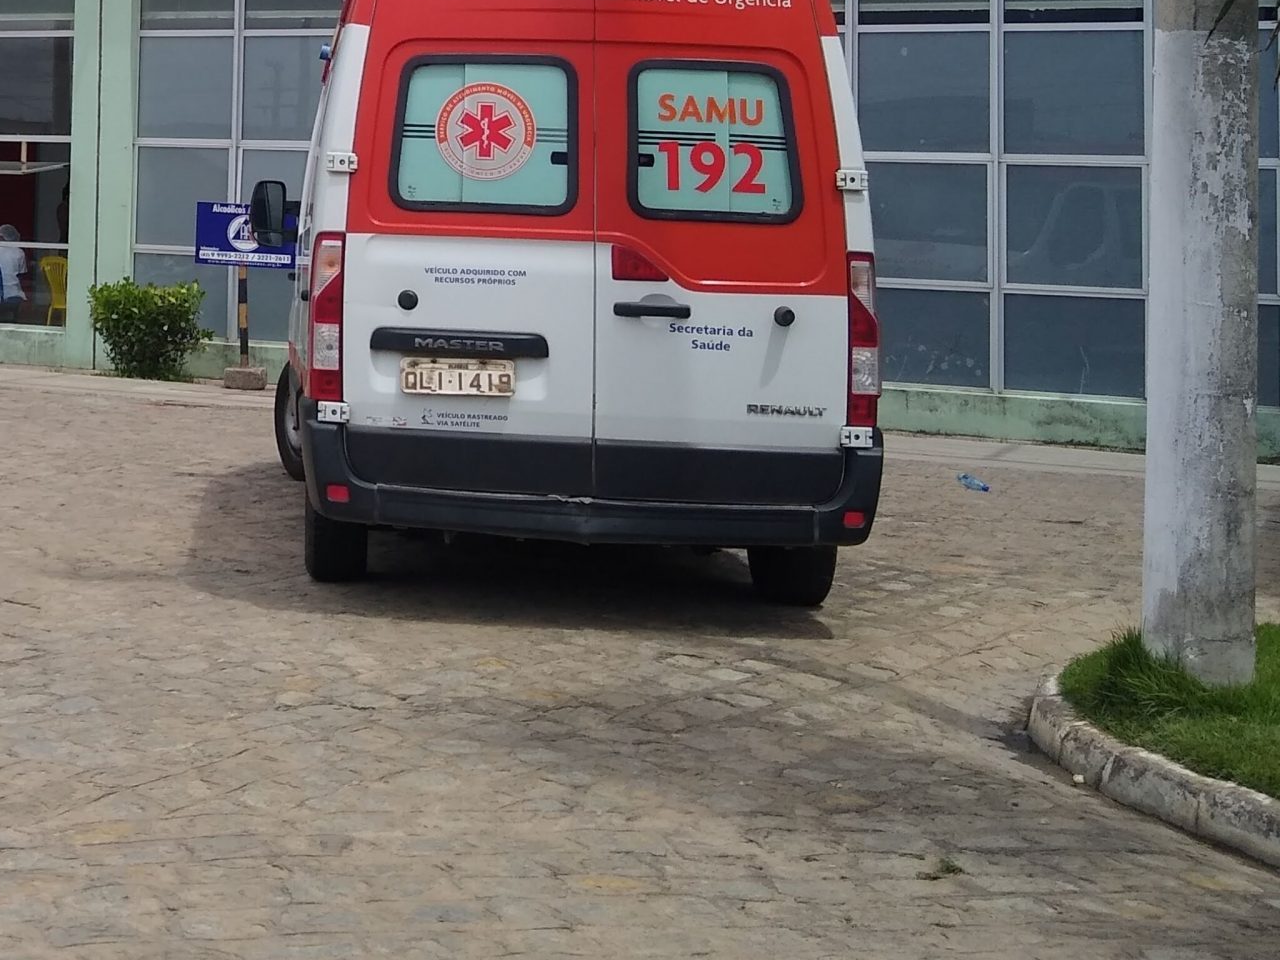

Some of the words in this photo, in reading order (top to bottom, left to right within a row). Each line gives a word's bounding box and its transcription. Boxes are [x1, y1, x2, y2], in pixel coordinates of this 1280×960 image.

[657, 93, 764, 127] SAMU
[658, 141, 766, 194] 192
[424, 267, 458, 275] VEÍCULO
[459, 268, 506, 277] ADQUIRIDO
[434, 276, 475, 285] RECURSOS
[477, 276, 516, 286] PRÓPRIOS
[669, 323, 734, 337] Secretaria
[737, 326, 753, 338] da
[414, 337, 505, 352] MASTER
[691, 339, 731, 352] Saúde
[436, 412, 465, 420] VEÍCULO
[467, 413, 509, 422] RASTREADO
[746, 403, 827, 417] RENAULT
